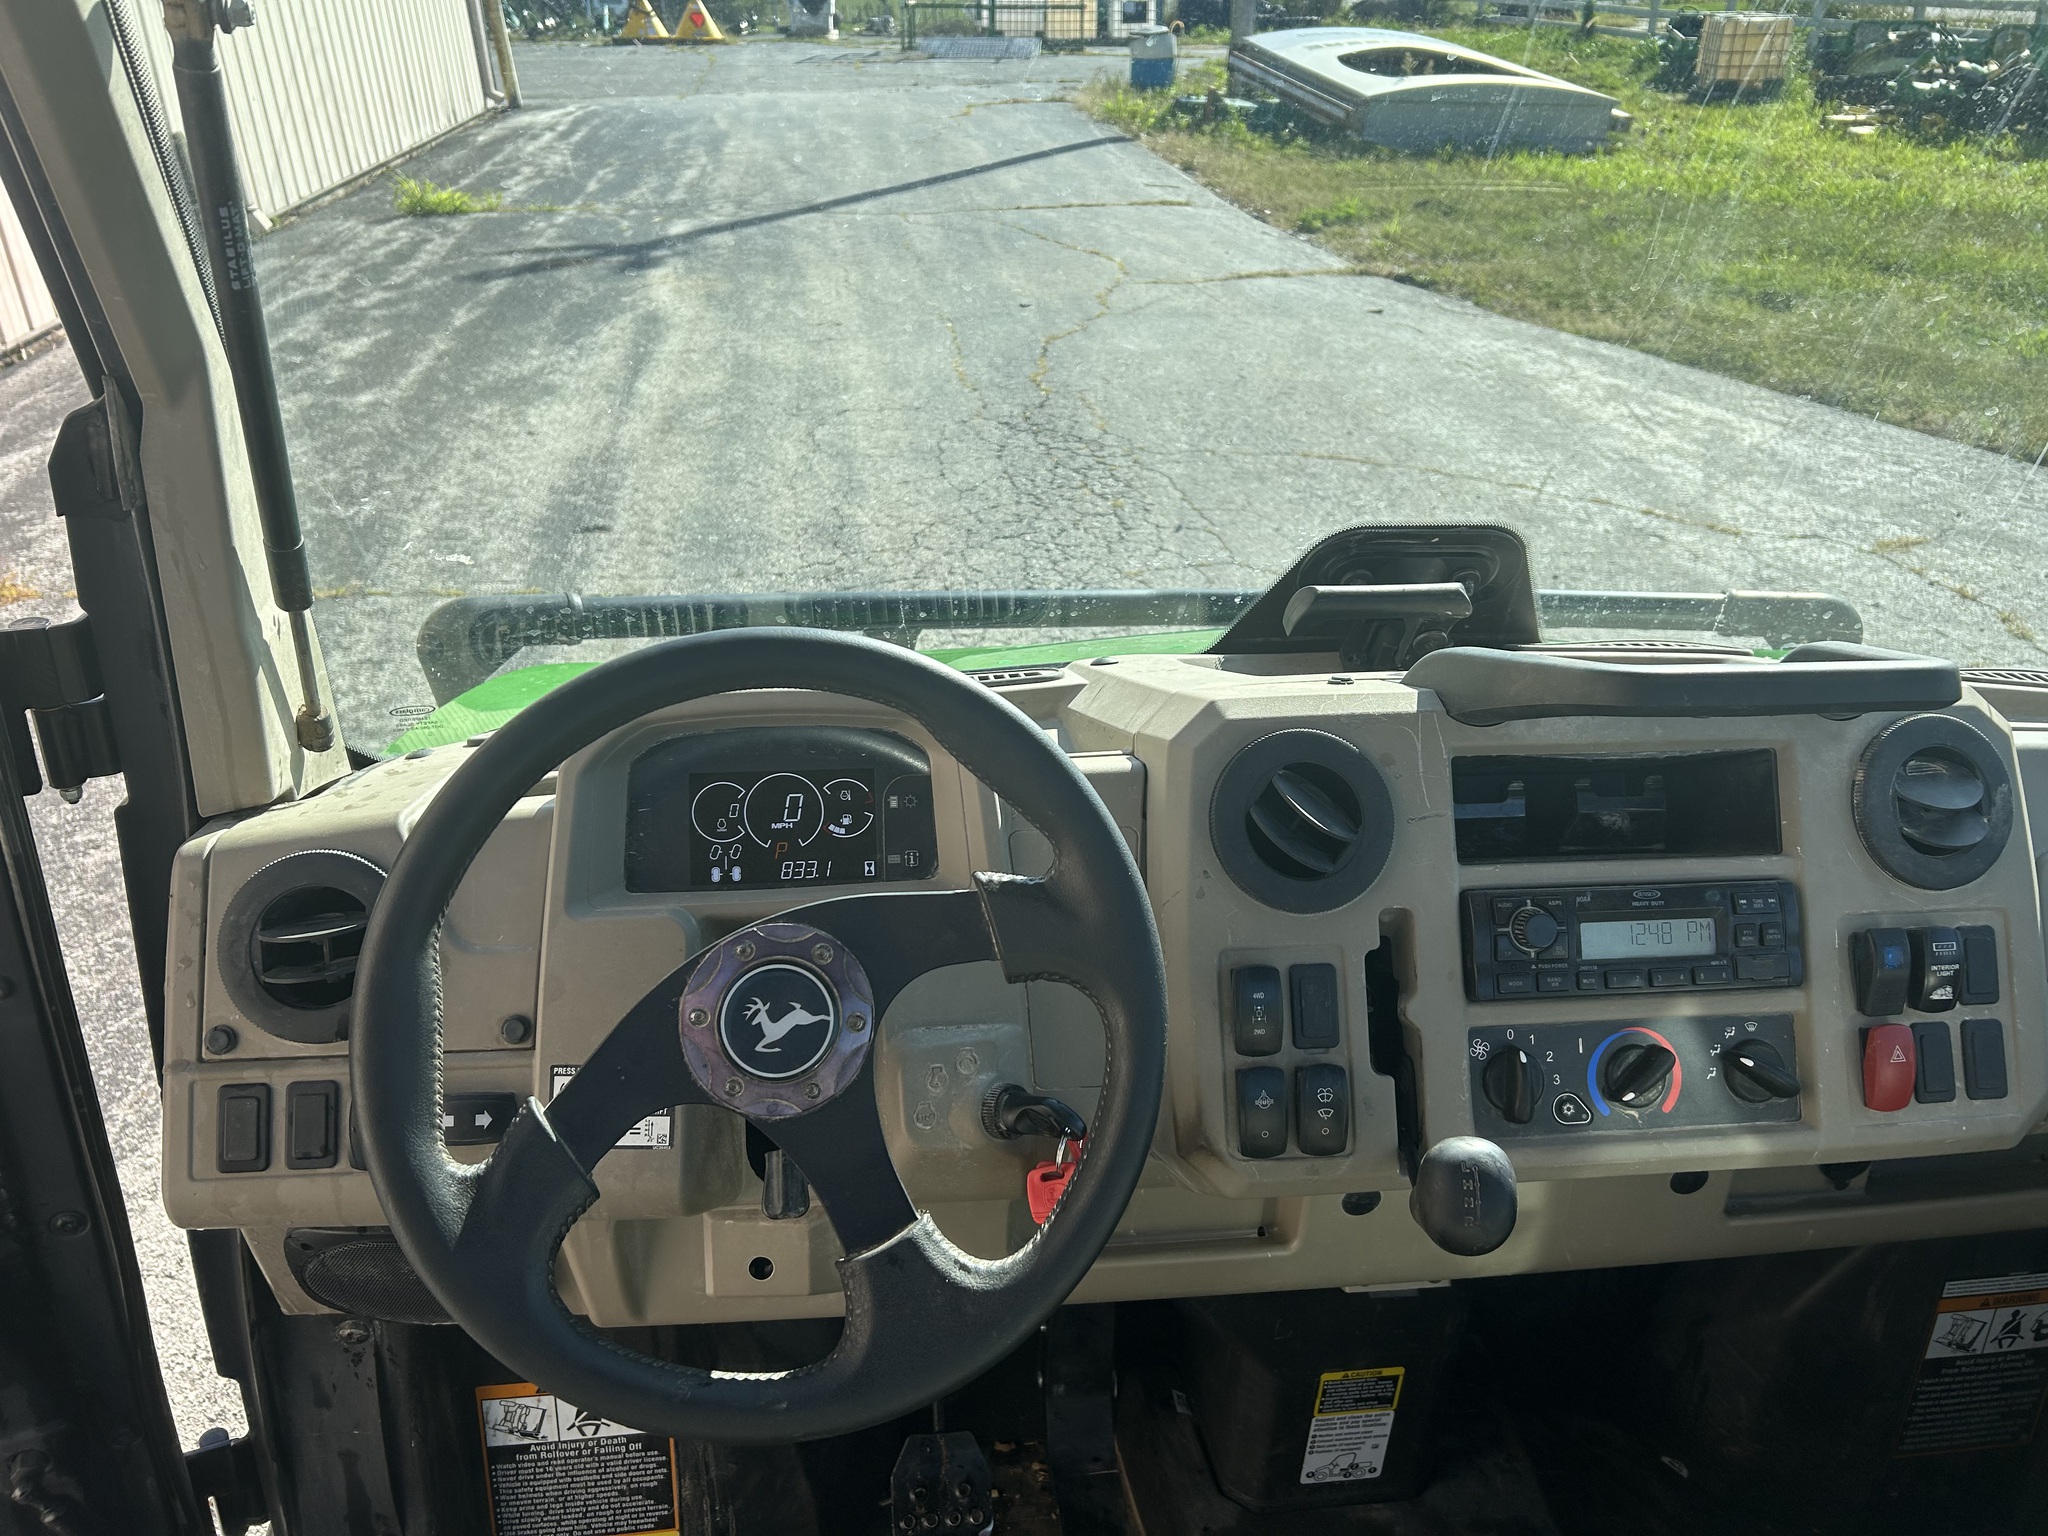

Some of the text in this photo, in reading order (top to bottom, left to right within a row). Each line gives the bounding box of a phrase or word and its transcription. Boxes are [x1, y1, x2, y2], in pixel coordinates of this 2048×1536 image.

[729, 803, 740, 818] 0
[783, 793, 804, 822] 0
[771, 822, 794, 830] MPH
[775, 842, 788, 859] P
[780, 860, 832, 880] 833.1
[1686, 920, 1712, 943] PM
[1931, 963, 1960, 971] INTERIOR
[1506, 1029, 1514, 1040] 0
[1528, 1033, 1535, 1045] 1
[1546, 1051, 1554, 1062] 2
[1553, 1074, 1560, 1085] 3
[1350, 1369, 1383, 1378] CAUTION
[530, 1435, 626, 1451] Avoid Injury or Death
[516, 1442, 641, 1461] from Rollover or Falling Off
